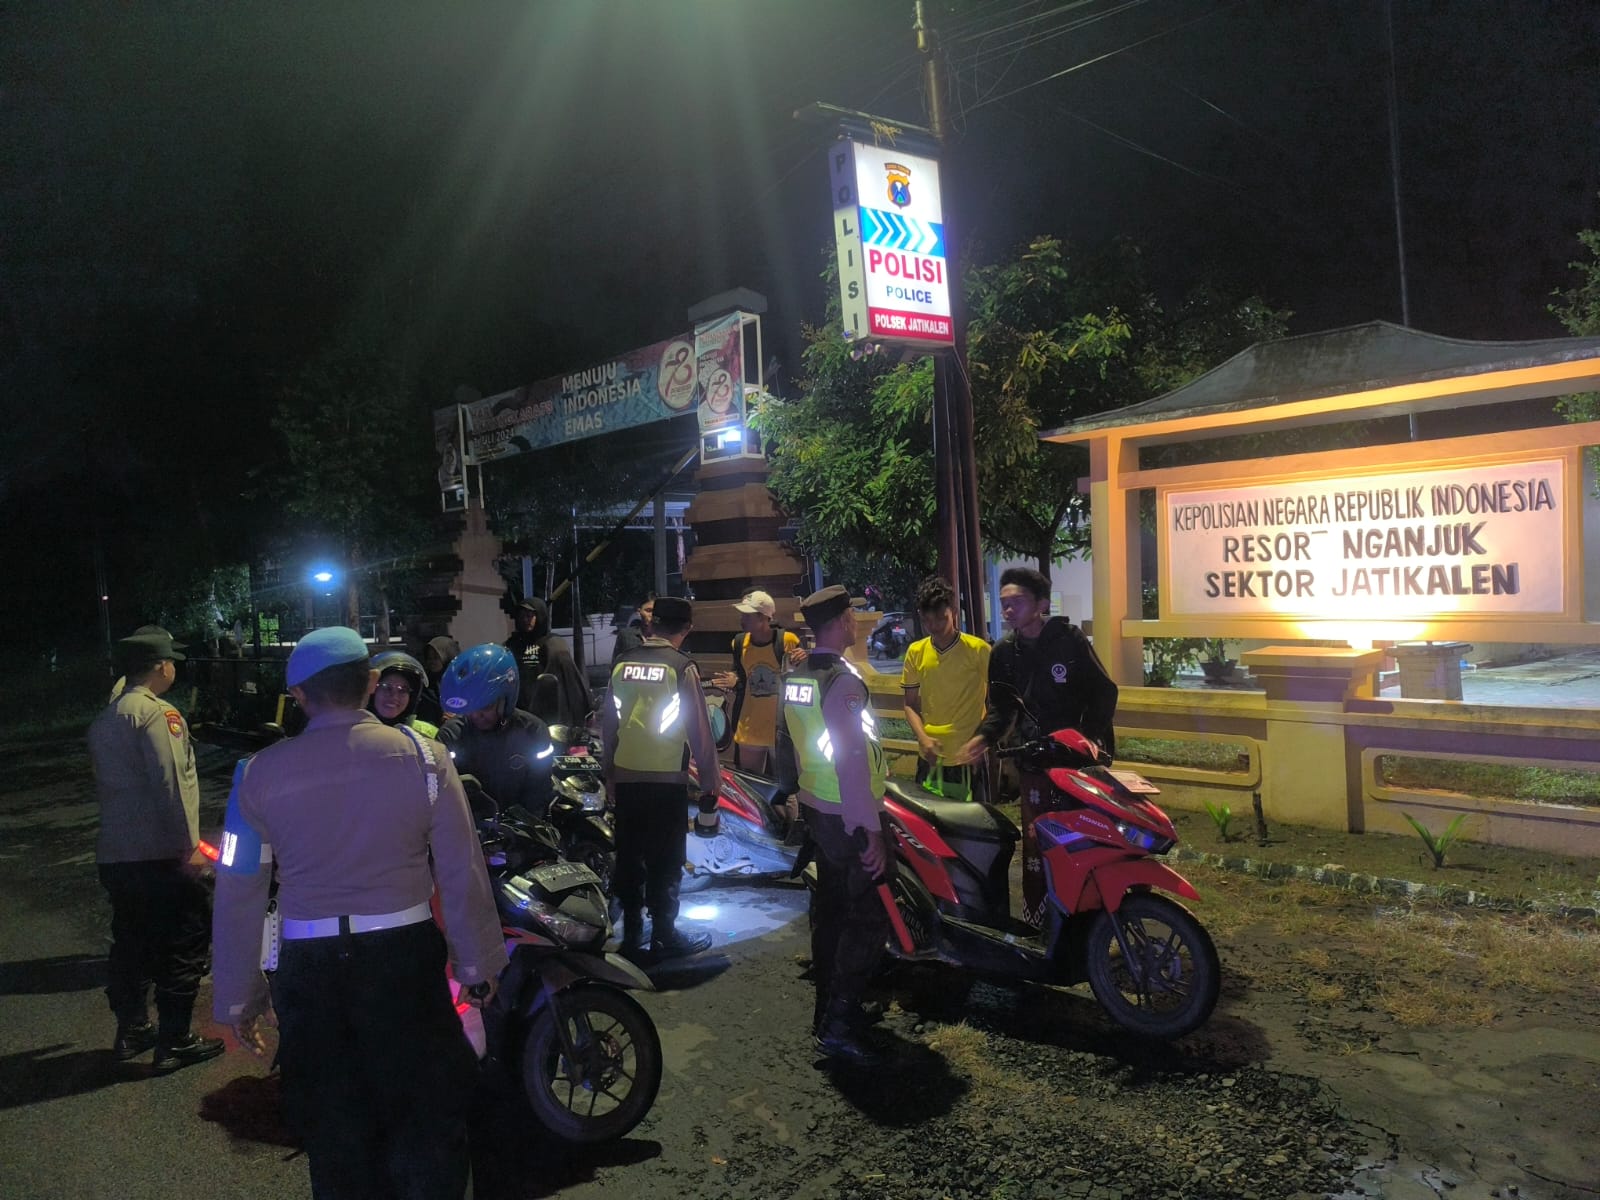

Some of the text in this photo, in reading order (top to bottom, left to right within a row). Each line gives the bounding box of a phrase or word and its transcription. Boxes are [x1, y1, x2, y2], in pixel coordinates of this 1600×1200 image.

[836, 153, 860, 331] POLISI
[869, 249, 942, 284] POLISI
[886, 285, 932, 304] POLICE
[874, 313, 949, 335] POLSEK JATIKALEN
[562, 361, 616, 394] MENUJU
[563, 378, 642, 415] INDONESIA
[565, 411, 602, 435] EMAS
[1174, 478, 1556, 531] KEPOLISIAN NEGARA REPUBLIK INDONESIA
[1343, 521, 1488, 559] NGANJUK
[1205, 563, 1520, 598] SEKTOR JATIKALEN
[623, 665, 665, 681] POLISI
[784, 684, 813, 703] POLISI
[1079, 814, 1109, 830] HONDA
